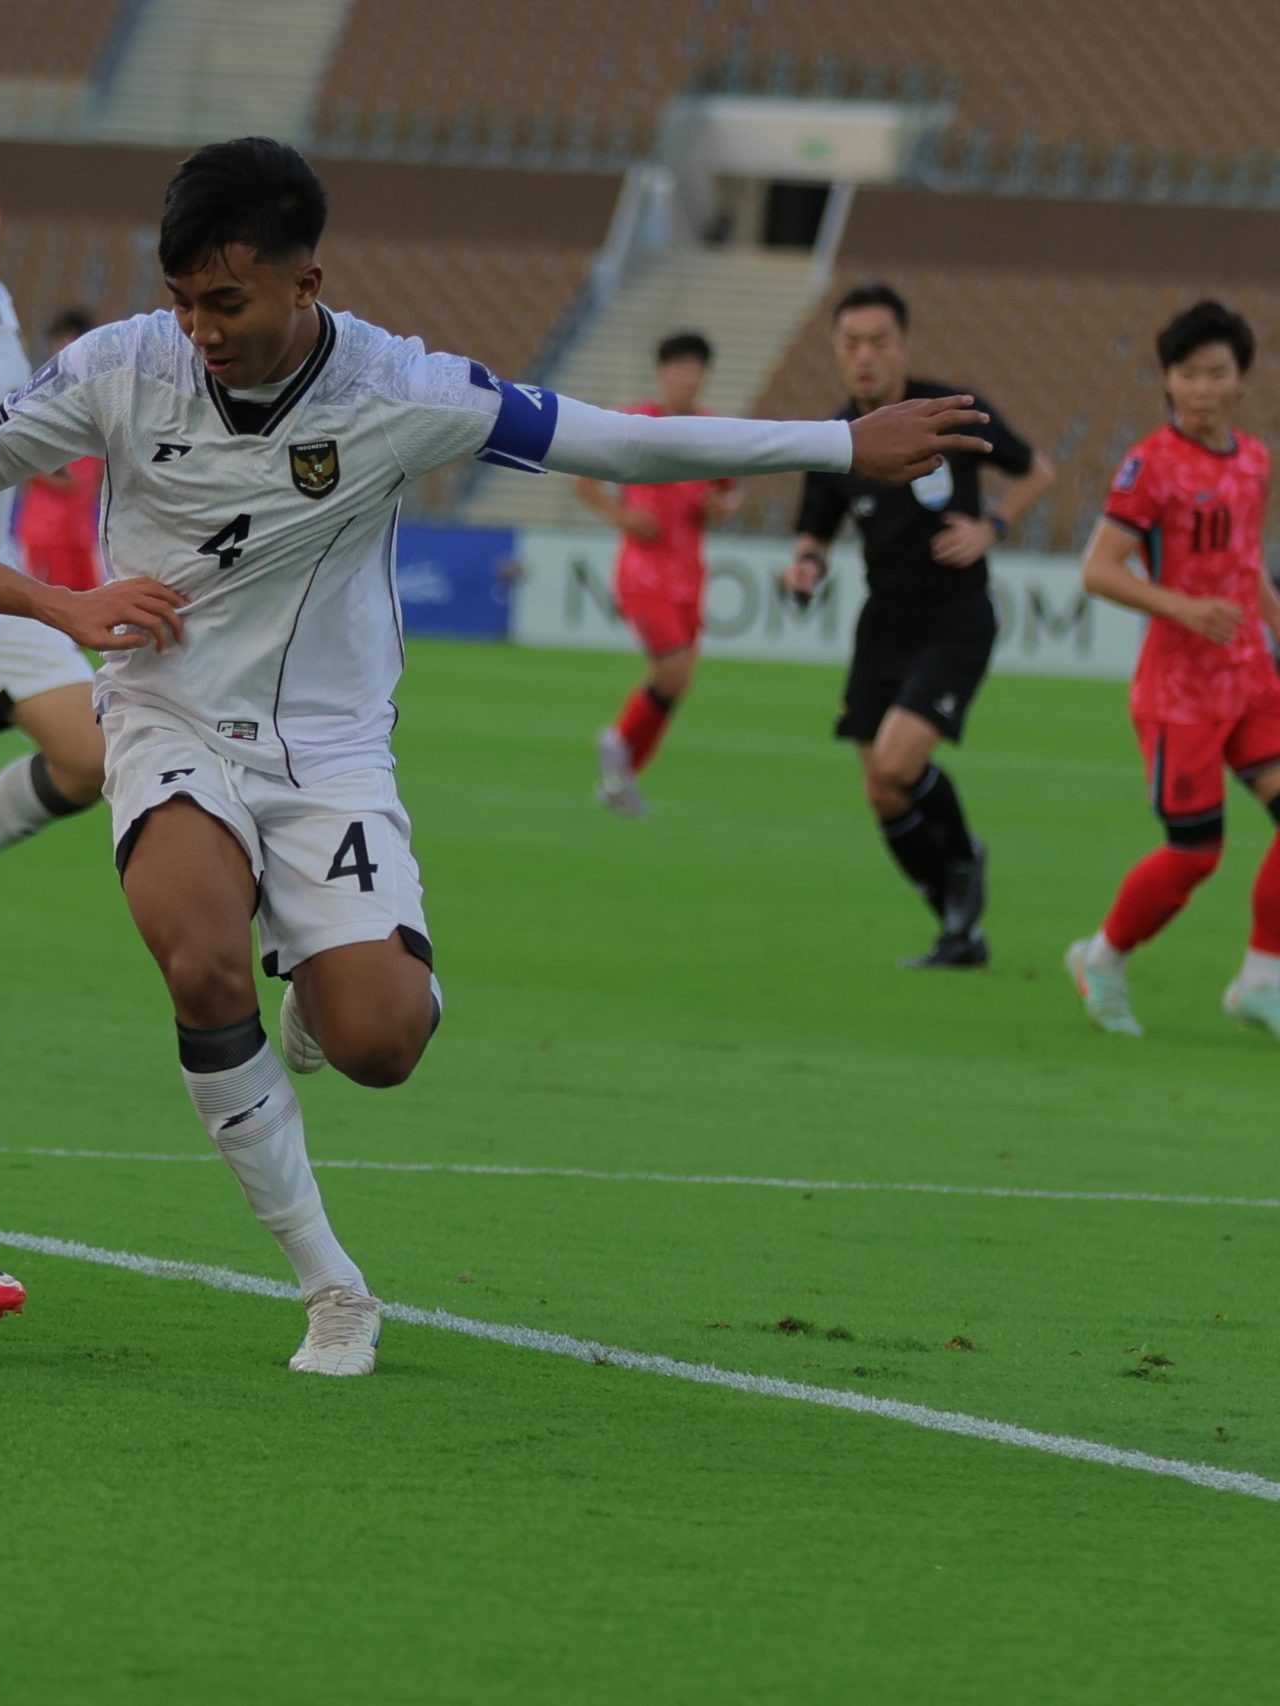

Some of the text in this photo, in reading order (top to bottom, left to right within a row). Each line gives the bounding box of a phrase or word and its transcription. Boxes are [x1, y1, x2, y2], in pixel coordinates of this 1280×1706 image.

[196, 513, 251, 569] 4
[1192, 506, 1231, 554] 10
[325, 821, 378, 892] 4
